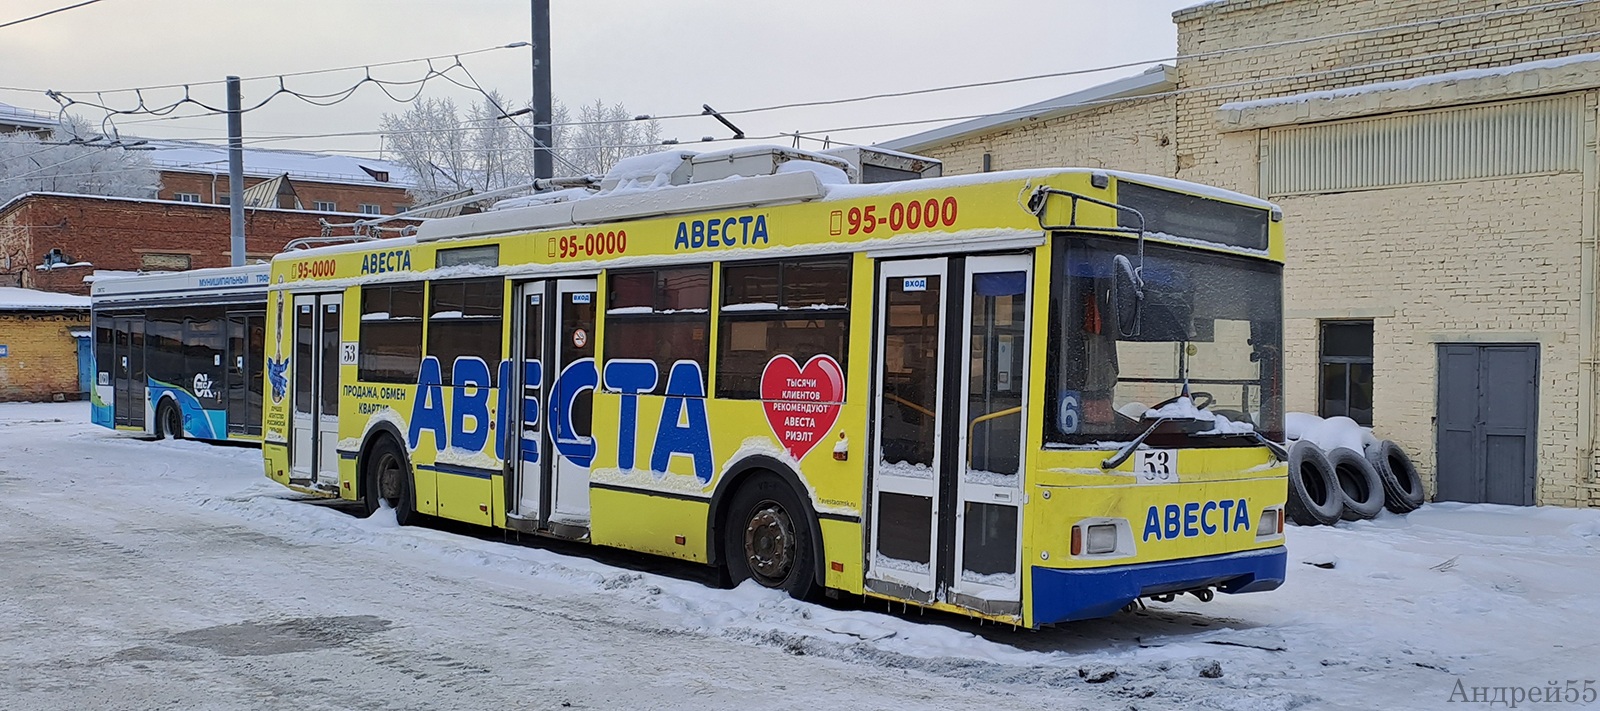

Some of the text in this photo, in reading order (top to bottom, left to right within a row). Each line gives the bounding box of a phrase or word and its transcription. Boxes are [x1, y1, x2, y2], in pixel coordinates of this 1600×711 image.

[847, 196, 958, 235] 95-0000
[673, 214, 768, 250] АВЕСТА
[558, 230, 627, 259] 95-0000
[298, 259, 336, 278] 95-0000
[361, 250, 411, 274] АВЕСТА
[199, 274, 249, 287] МУНИЦИПАЛЬНЫЙ
[905, 280, 925, 288] ВХОД
[344, 344, 356, 362] 53
[786, 378, 817, 387] ТЫСЯЧИ
[343, 385, 406, 400] ПРОДАЖА, ОБМЕН
[782, 390, 821, 400] КЛИЕНТОВ
[408, 356, 715, 488] АВЕСТА
[784, 417, 816, 428] АВЕСТА
[1060, 395, 1079, 434] 6
[785, 431, 813, 441] РИЭЛТ
[1143, 451, 1170, 481] 53
[1142, 498, 1250, 542] АВЕСТА
